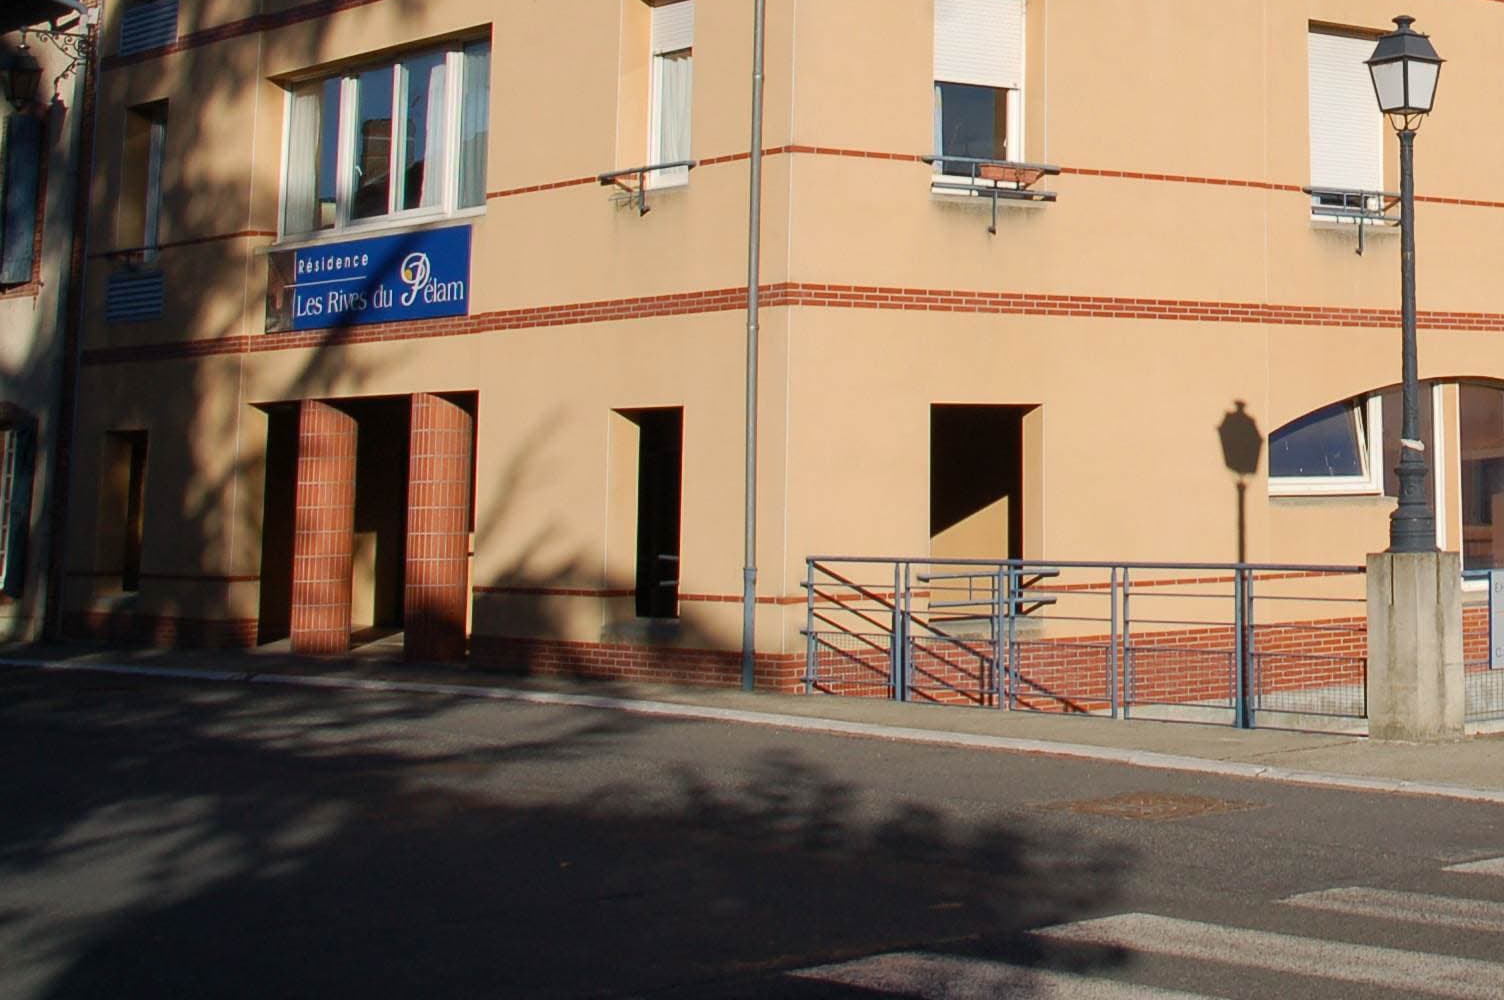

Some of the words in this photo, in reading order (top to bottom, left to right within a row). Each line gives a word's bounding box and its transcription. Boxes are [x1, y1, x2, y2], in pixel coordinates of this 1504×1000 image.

[297, 294, 323, 317] Les
[327, 289, 368, 314] Rives
[373, 284, 393, 309] du
[401, 252, 464, 306] Pélam
[298, 253, 369, 274] Résidence
